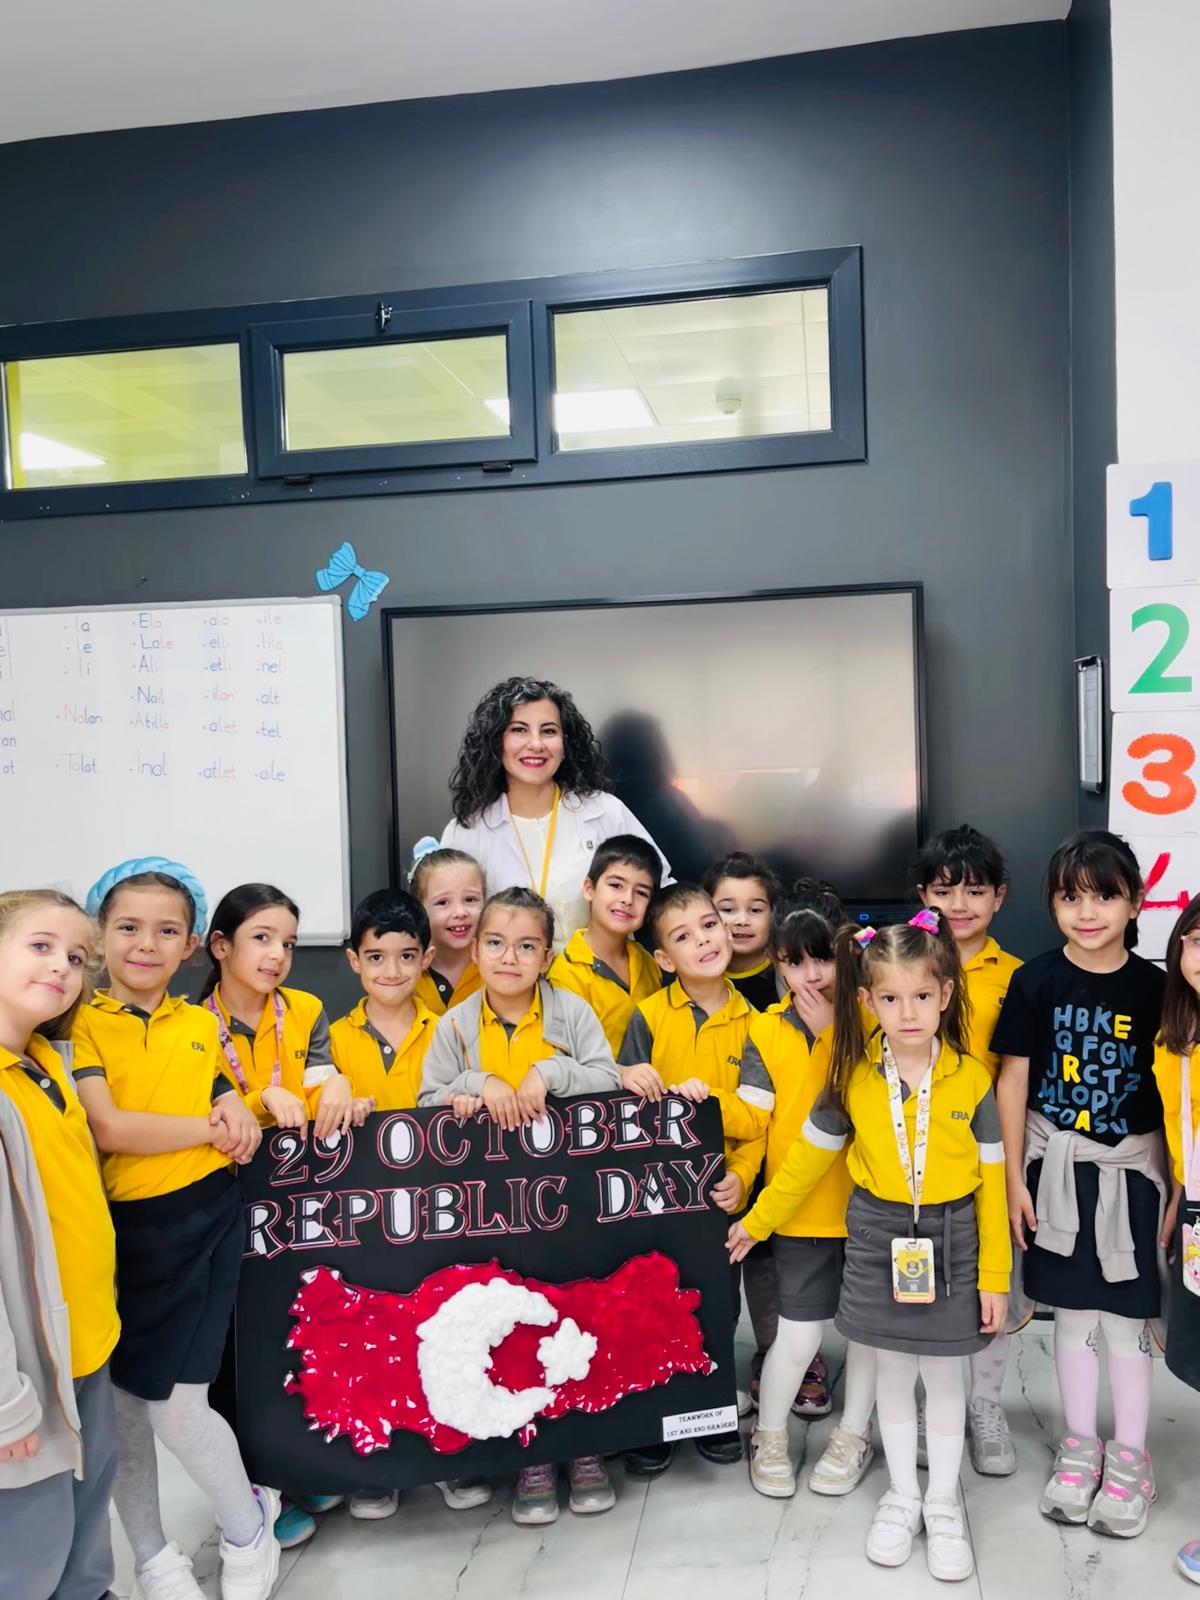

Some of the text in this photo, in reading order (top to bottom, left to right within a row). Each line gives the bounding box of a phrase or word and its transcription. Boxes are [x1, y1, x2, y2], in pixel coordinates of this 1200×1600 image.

[1129, 481, 1173, 561] 1
[138, 612, 163, 630] Ela
[140, 632, 174, 650] Lale
[1128, 602, 1193, 694] 2
[63, 704, 104, 725] Nalan
[260, 719, 283, 738] tel
[1122, 732, 1197, 816] 3
[951, 1110, 970, 1121] ERA
[269, 1095, 702, 1188] 29 OCTOBER
[241, 1152, 725, 1260] REPUBLIC DAY
[680, 1428, 692, 1436] AND
